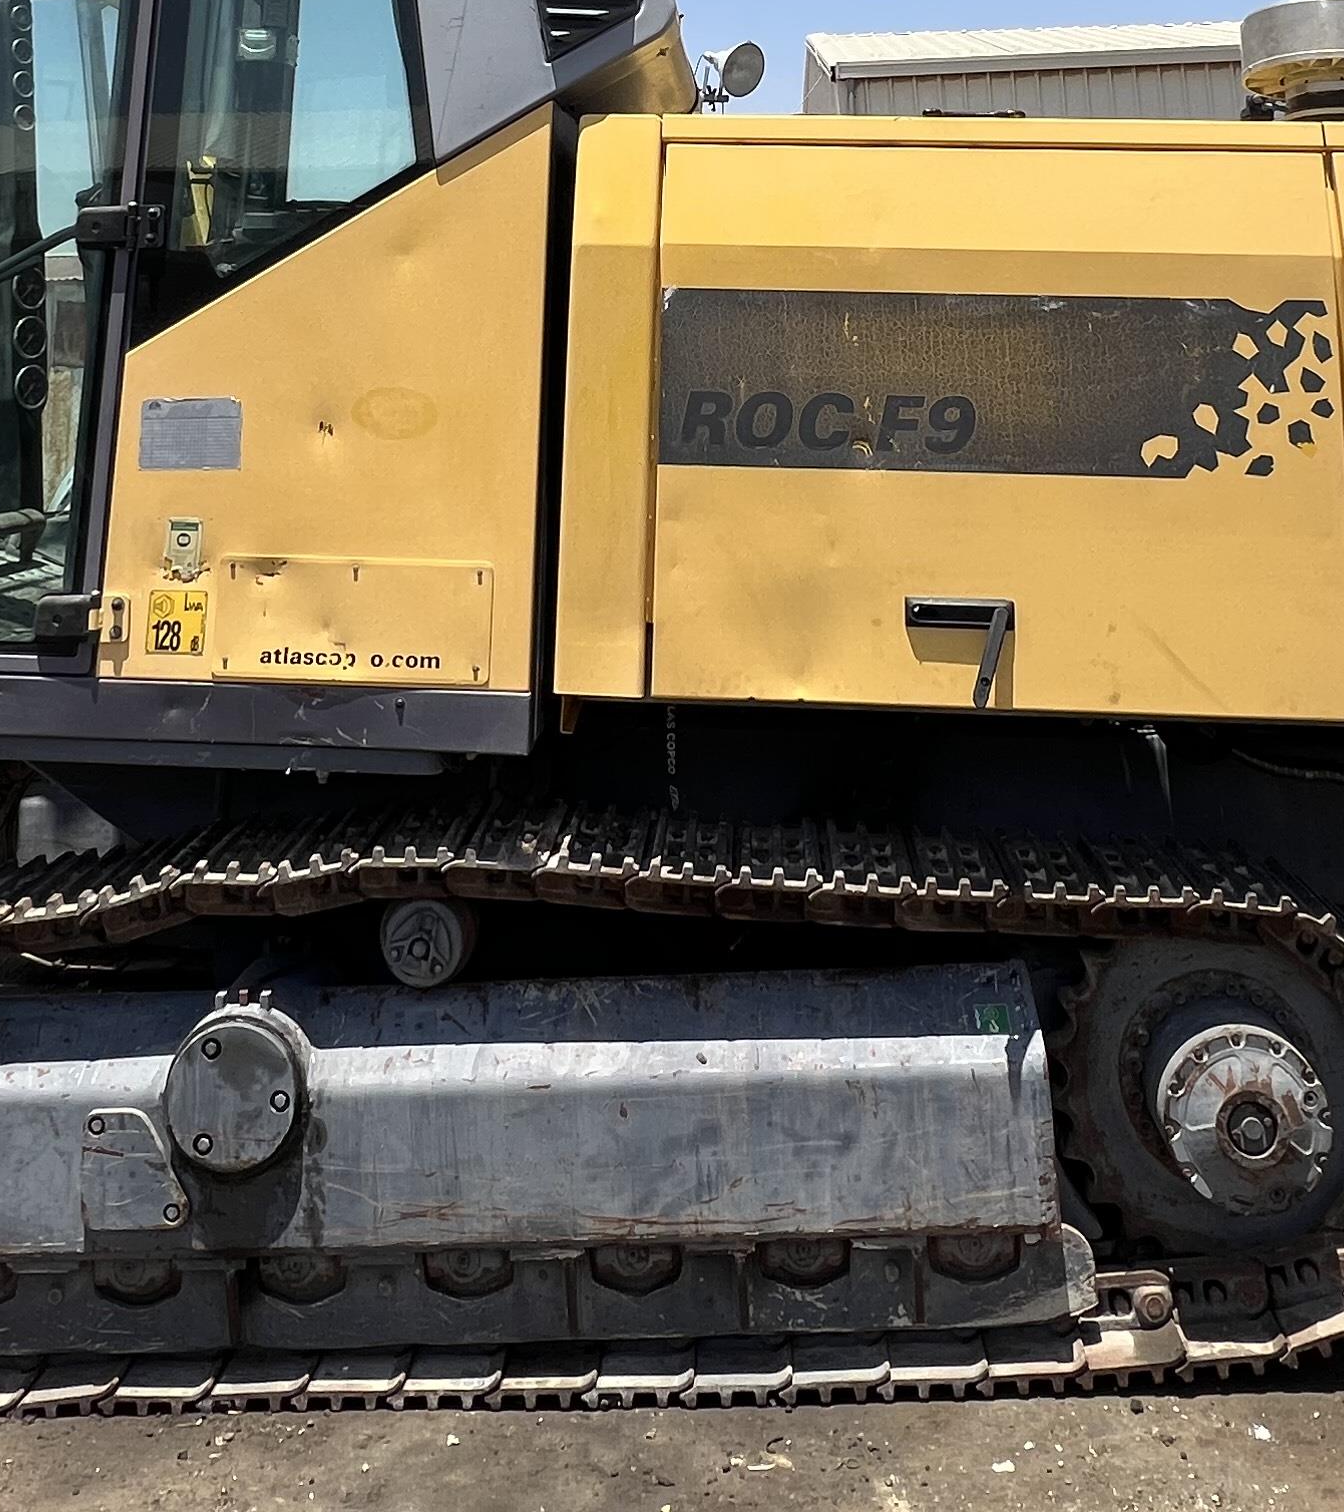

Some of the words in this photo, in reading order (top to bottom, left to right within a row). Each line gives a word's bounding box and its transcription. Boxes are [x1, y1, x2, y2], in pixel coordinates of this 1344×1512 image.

[681, 390, 855, 452] ROC
[875, 394, 976, 454] F9
[152, 619, 182, 651] 128
[259, 646, 441, 671] atlascopo.com
